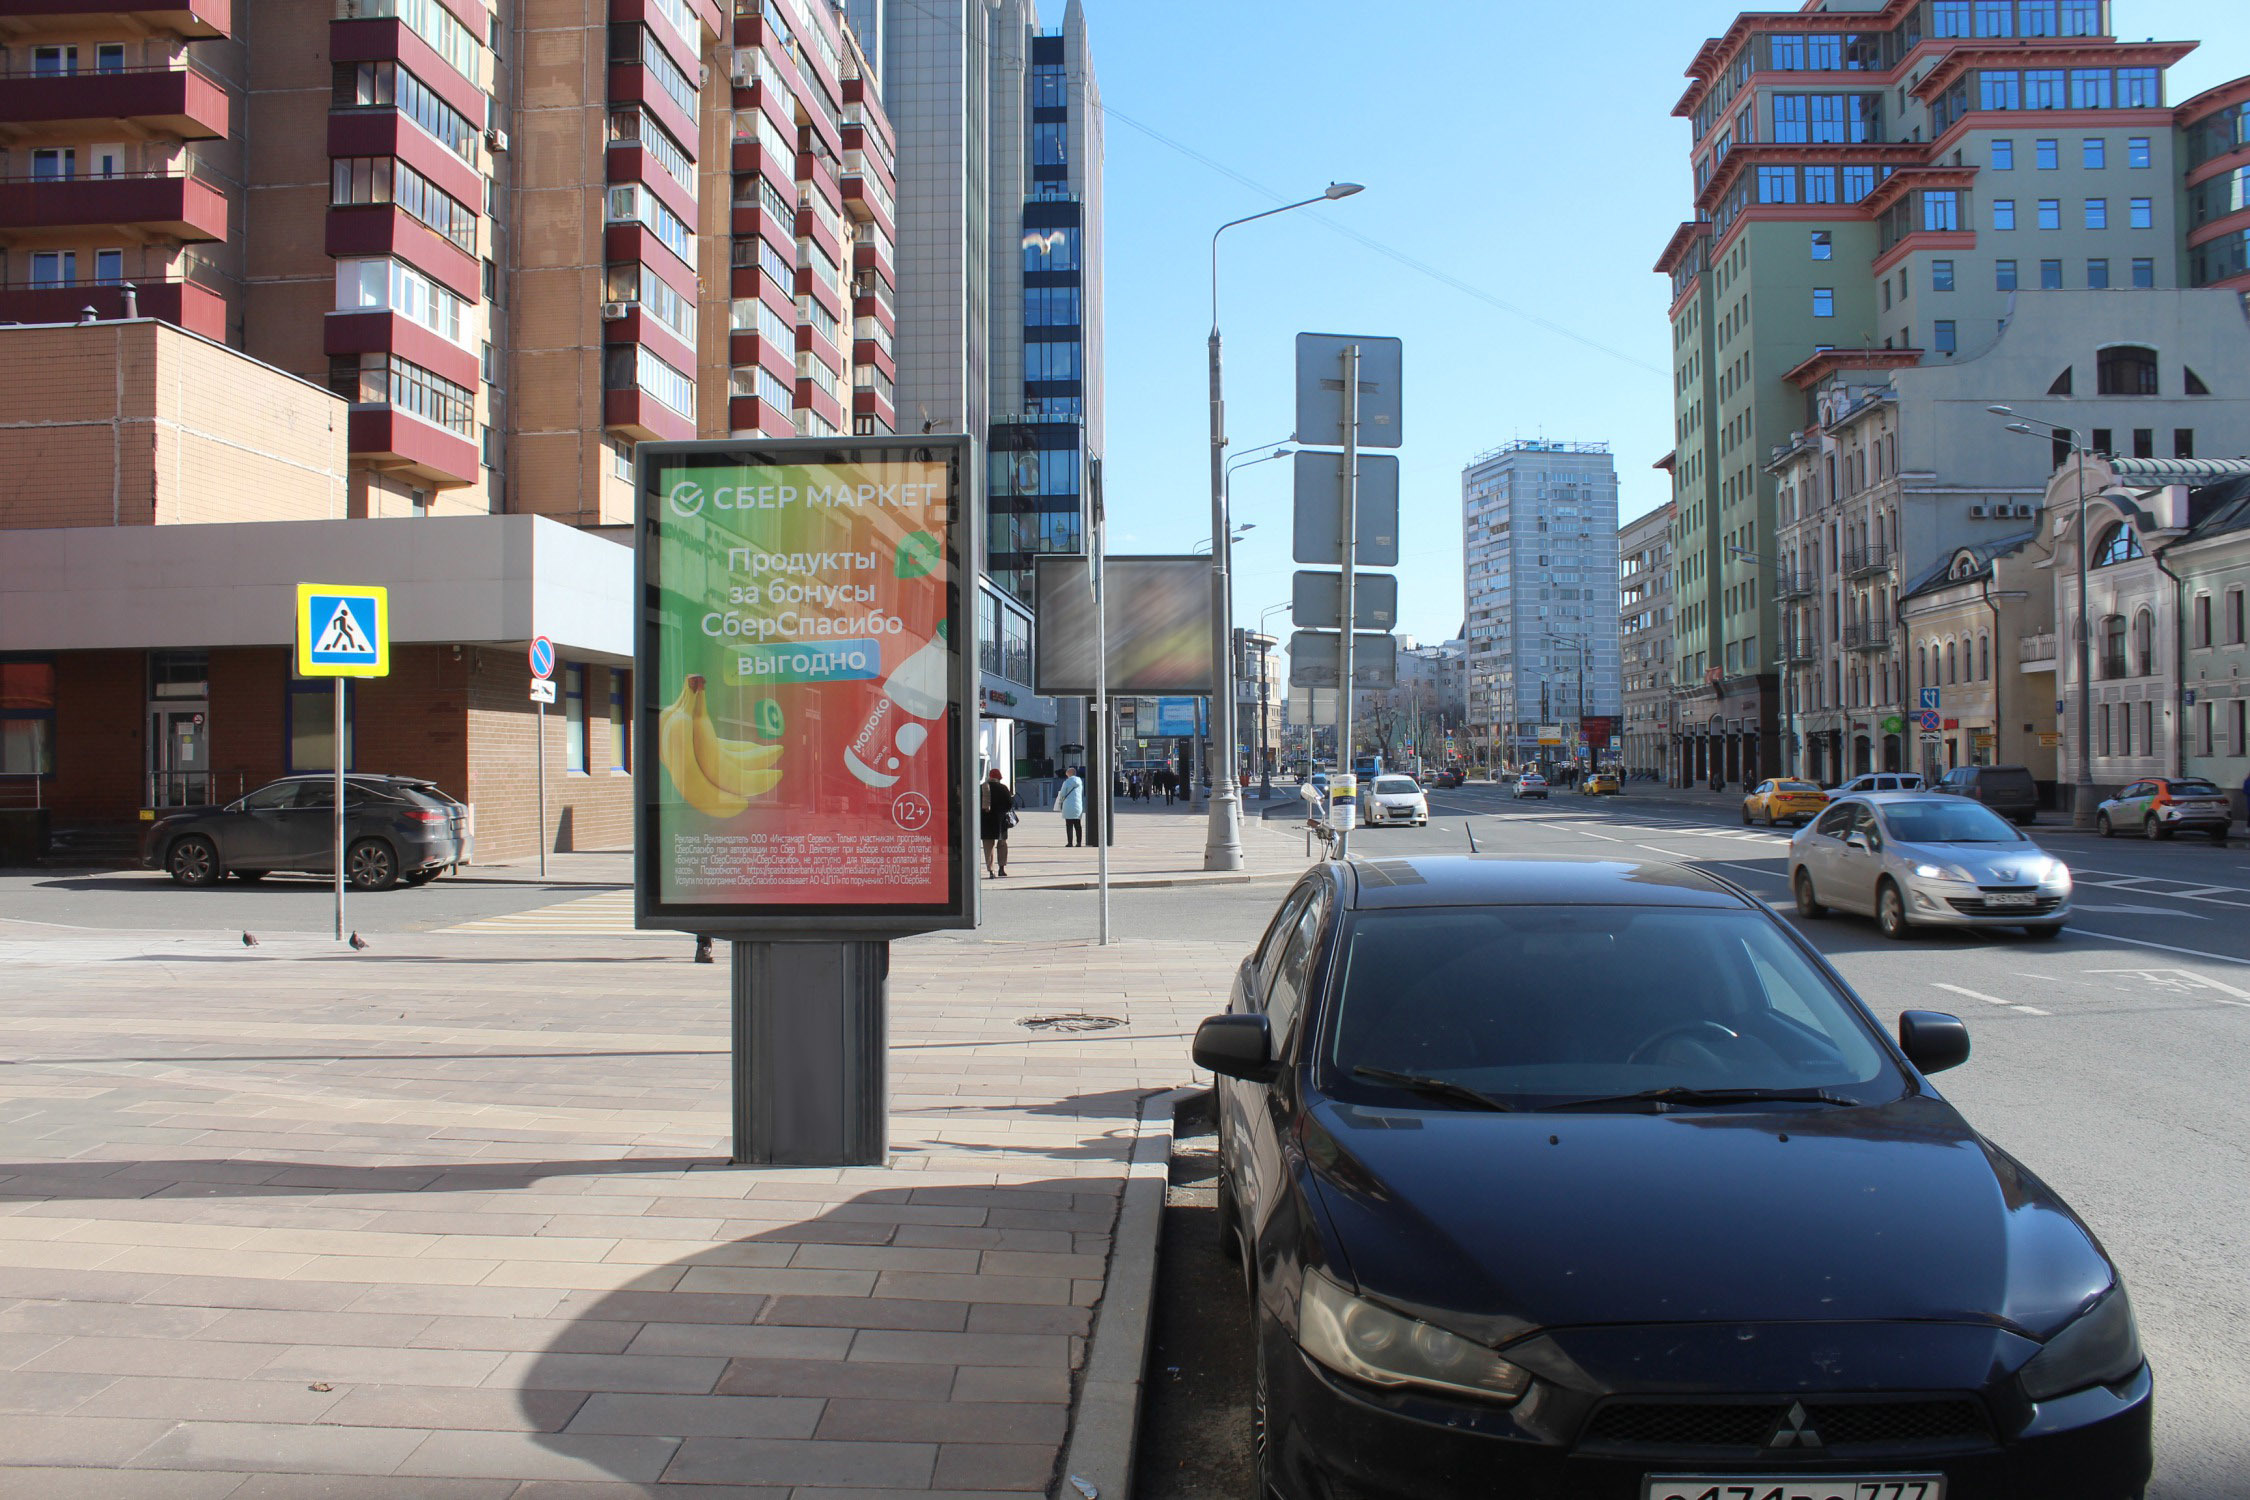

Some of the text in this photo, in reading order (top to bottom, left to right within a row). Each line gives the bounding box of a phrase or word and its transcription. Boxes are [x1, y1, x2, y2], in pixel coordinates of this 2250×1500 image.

[713, 483, 938, 511] СБЕР МАРКЕТ
[728, 547, 876, 577] Продукты
[729, 578, 876, 608] за бонусы
[701, 609, 903, 641] СберСпасибо
[737, 650, 867, 677] выгодно
[853, 698, 890, 754] МОЛОКО
[897, 801, 925, 821] 12+
[675, 844, 714, 855] СберСпасибо
[717, 846, 728, 855] при
[780, 844, 796, 855] Сбер
[809, 844, 840, 855] Действует
[842, 846, 854, 855] при
[857, 844, 878, 855] выборе
[881, 844, 906, 853] способа
[751, 834, 768, 843] ООО
[836, 834, 857, 843] Только
[860, 836, 894, 845] участникам
[897, 836, 932, 845] программы
[804, 856, 812, 864] не
[814, 856, 842, 865] доступно
[846, 856, 858, 865] для
[860, 856, 884, 865] товаров
[893, 854, 918, 864] оплатой
[675, 875, 695, 886] Услуги
[696, 877, 704, 885] по
[704, 877, 736, 886] программе
[738, 875, 777, 886] СберСпасибо
[779, 877, 808, 885] оказывает
[810, 875, 820, 885] АО
[842, 877, 850, 885] по
[851, 877, 884, 886] поручению
[885, 875, 900, 885] ПАО
